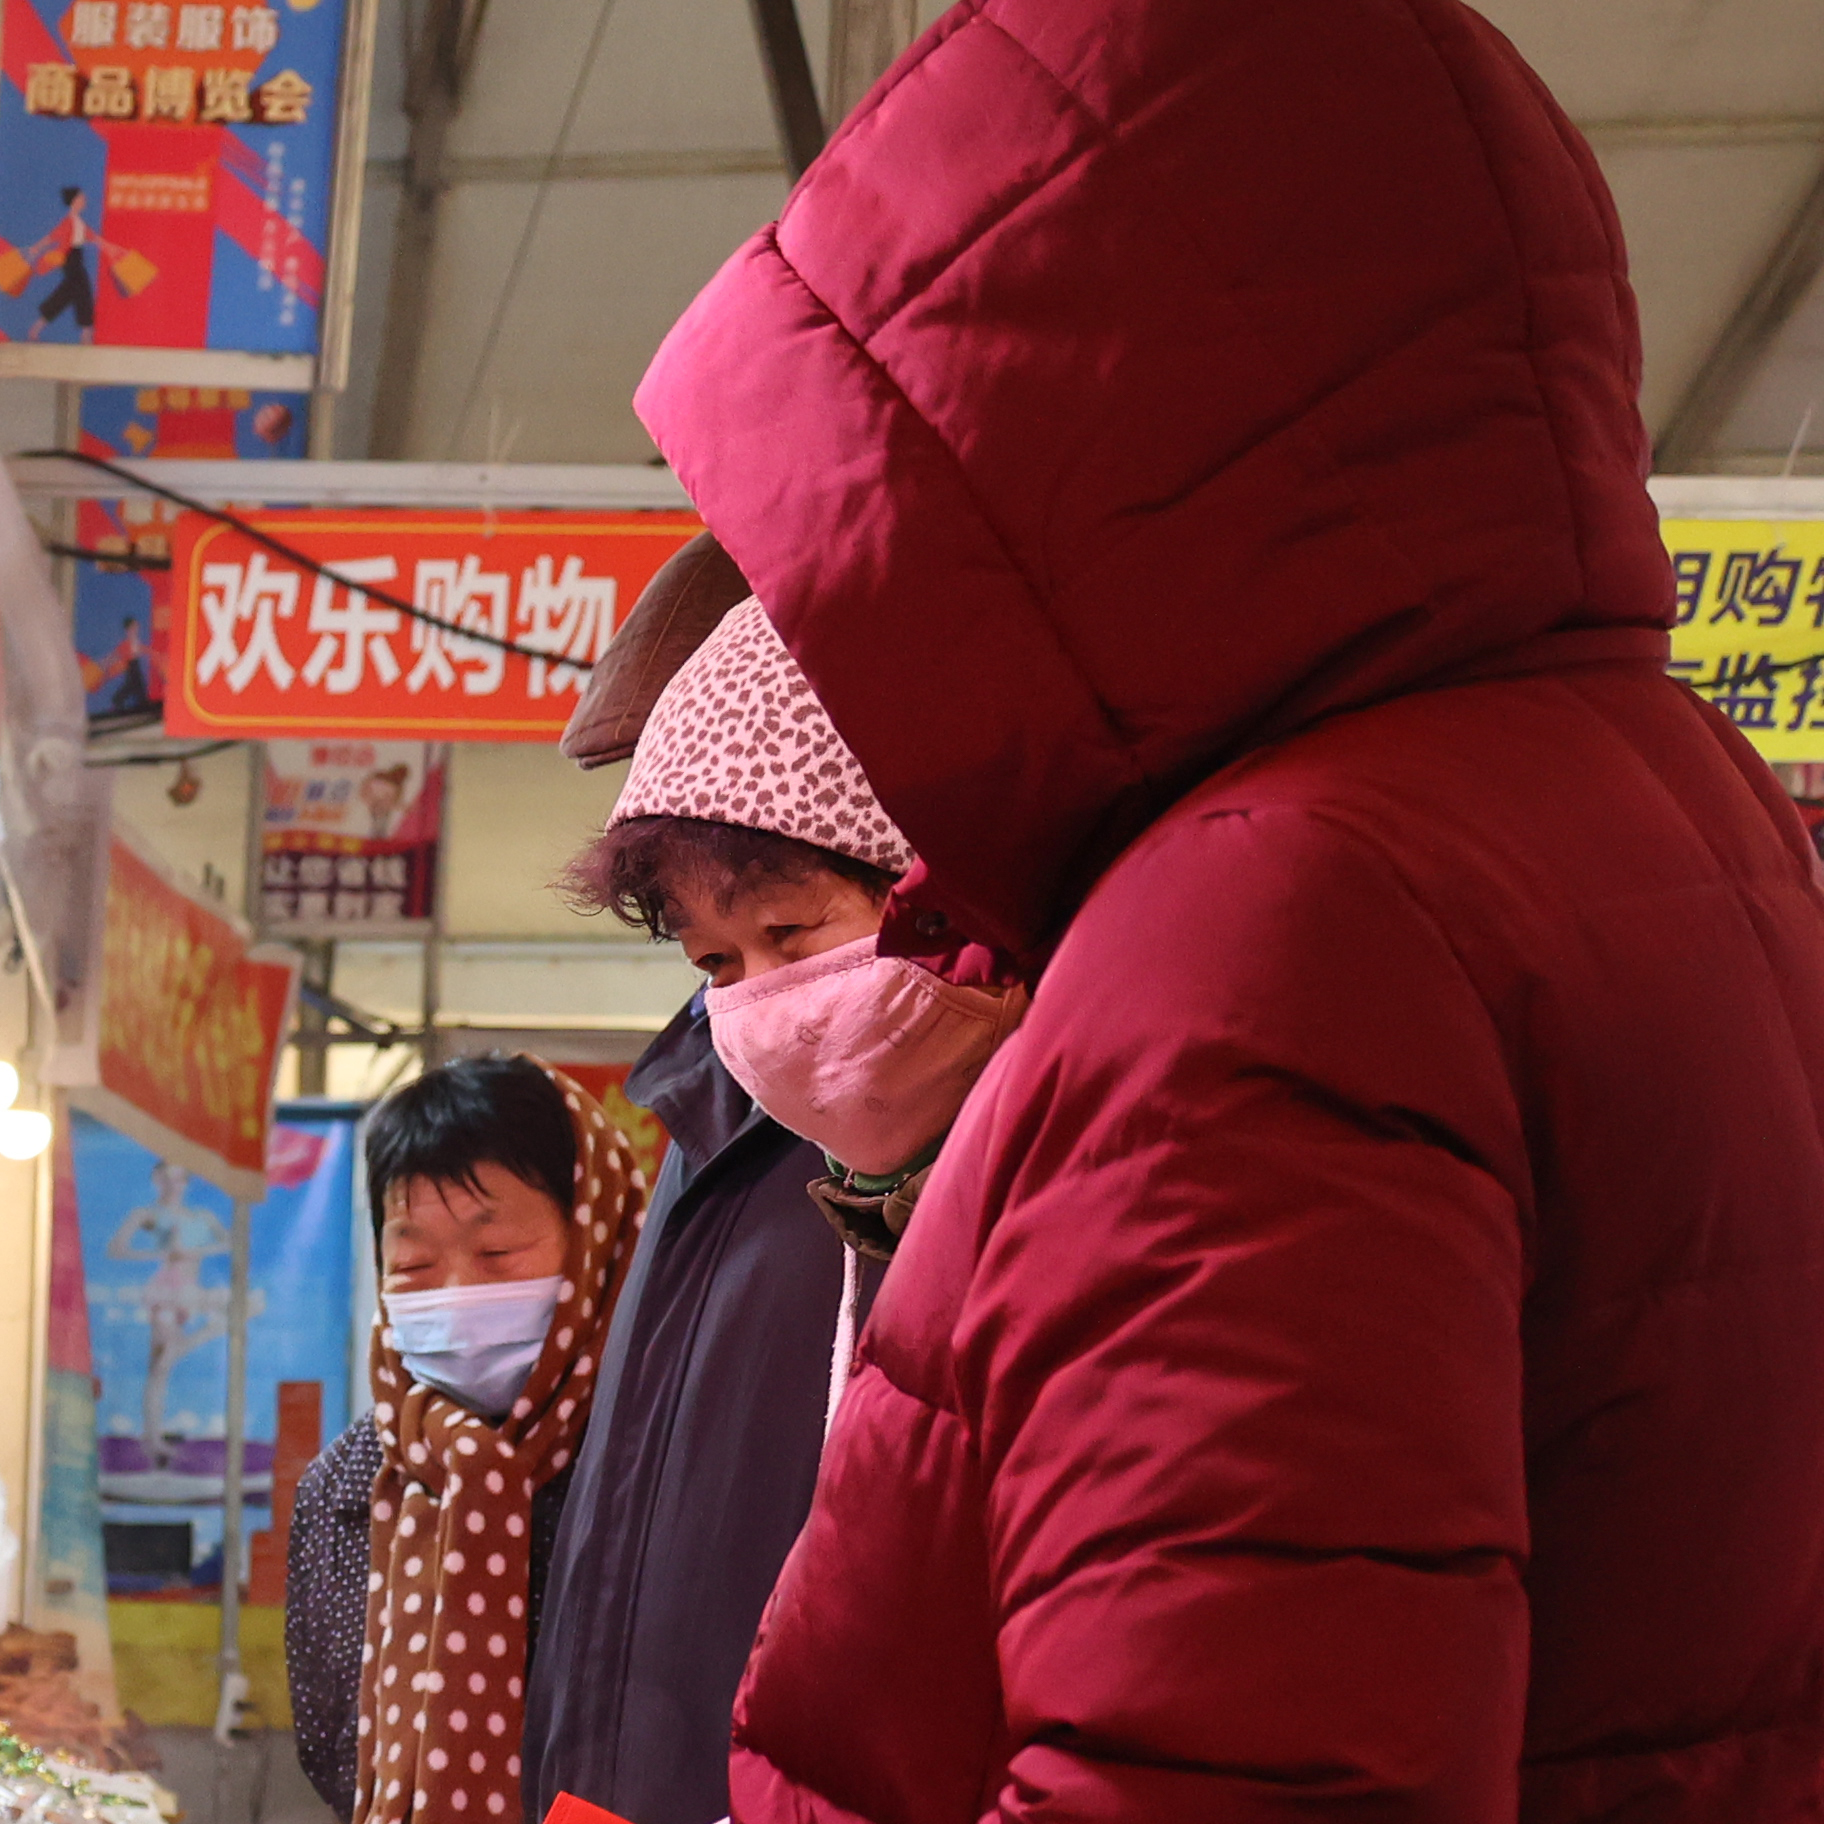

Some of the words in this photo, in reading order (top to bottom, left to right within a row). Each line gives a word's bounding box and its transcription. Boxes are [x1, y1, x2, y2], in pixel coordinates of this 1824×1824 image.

[71, 0, 280, 54] 服装服饰
[25, 62, 314, 122] 商品博览会
[196, 552, 618, 698] 欢乐购物
